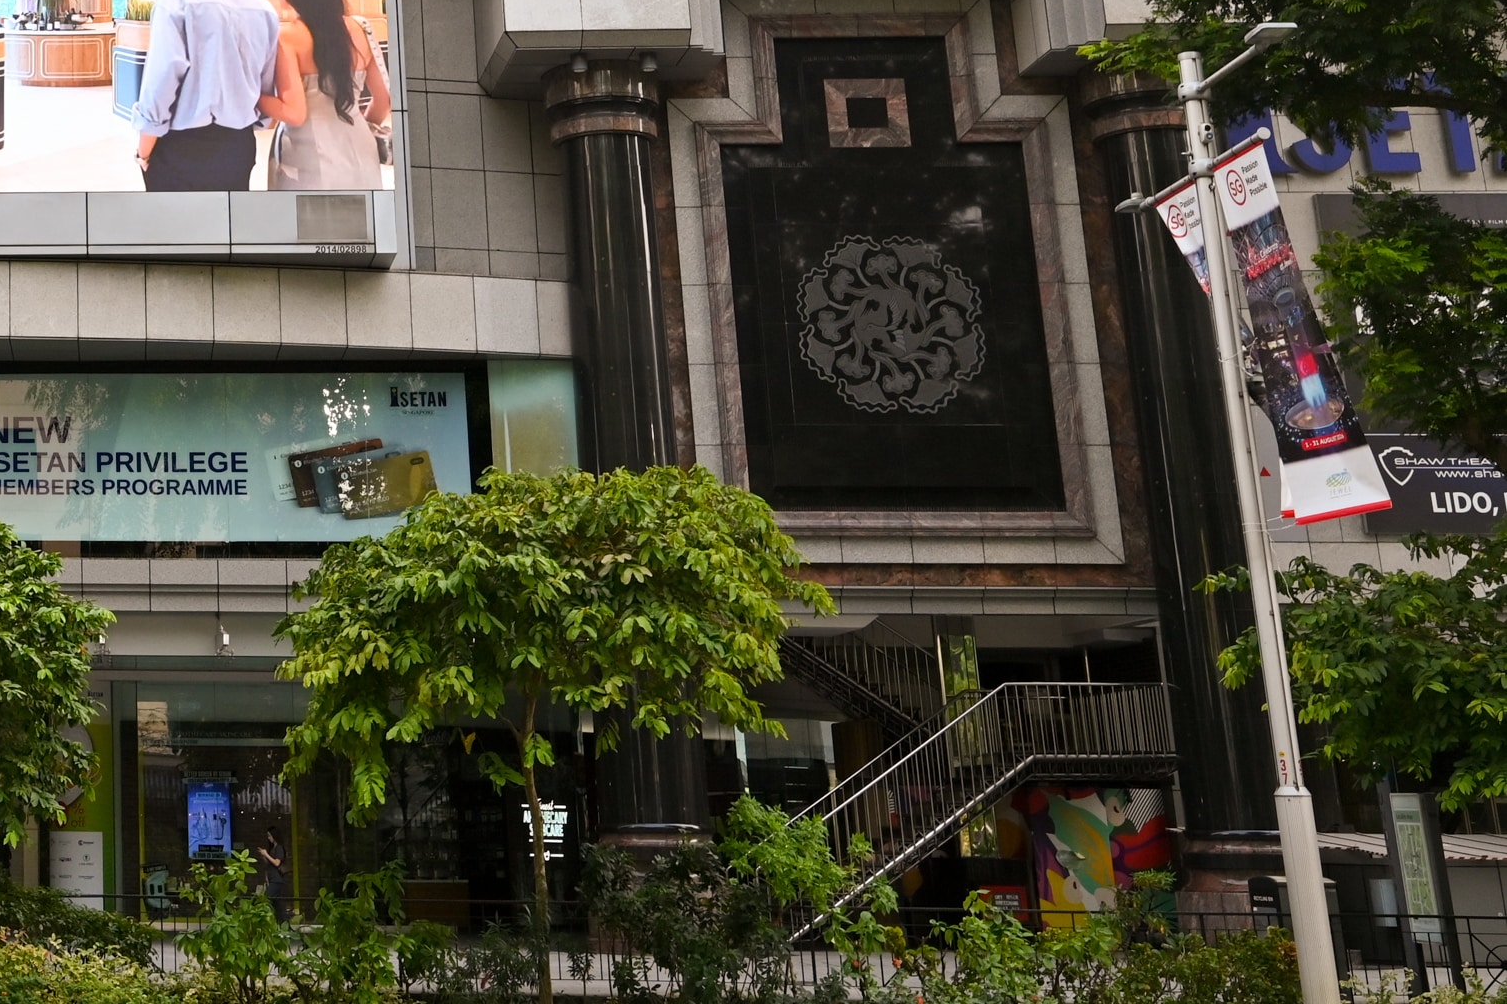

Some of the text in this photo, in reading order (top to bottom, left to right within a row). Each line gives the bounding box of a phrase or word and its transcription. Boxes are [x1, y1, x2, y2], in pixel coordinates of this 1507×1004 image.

[1240, 160, 1259, 174] Passion
[1245, 174, 1258, 185] Made
[1229, 179, 1243, 196] SG
[1249, 182, 1268, 196] Possible
[1171, 213, 1185, 229] SG
[315, 245, 367, 253] 2014/02898
[390, 387, 447, 407] ISETAN
[96, 451, 248, 473] PRIVILEGE
[1394, 457, 1497, 466] SHAW THEA
[1434, 468, 1505, 478] www.sha
[102, 479, 248, 495] PROGRAMME
[1430, 491, 1499, 517] LIDO,
